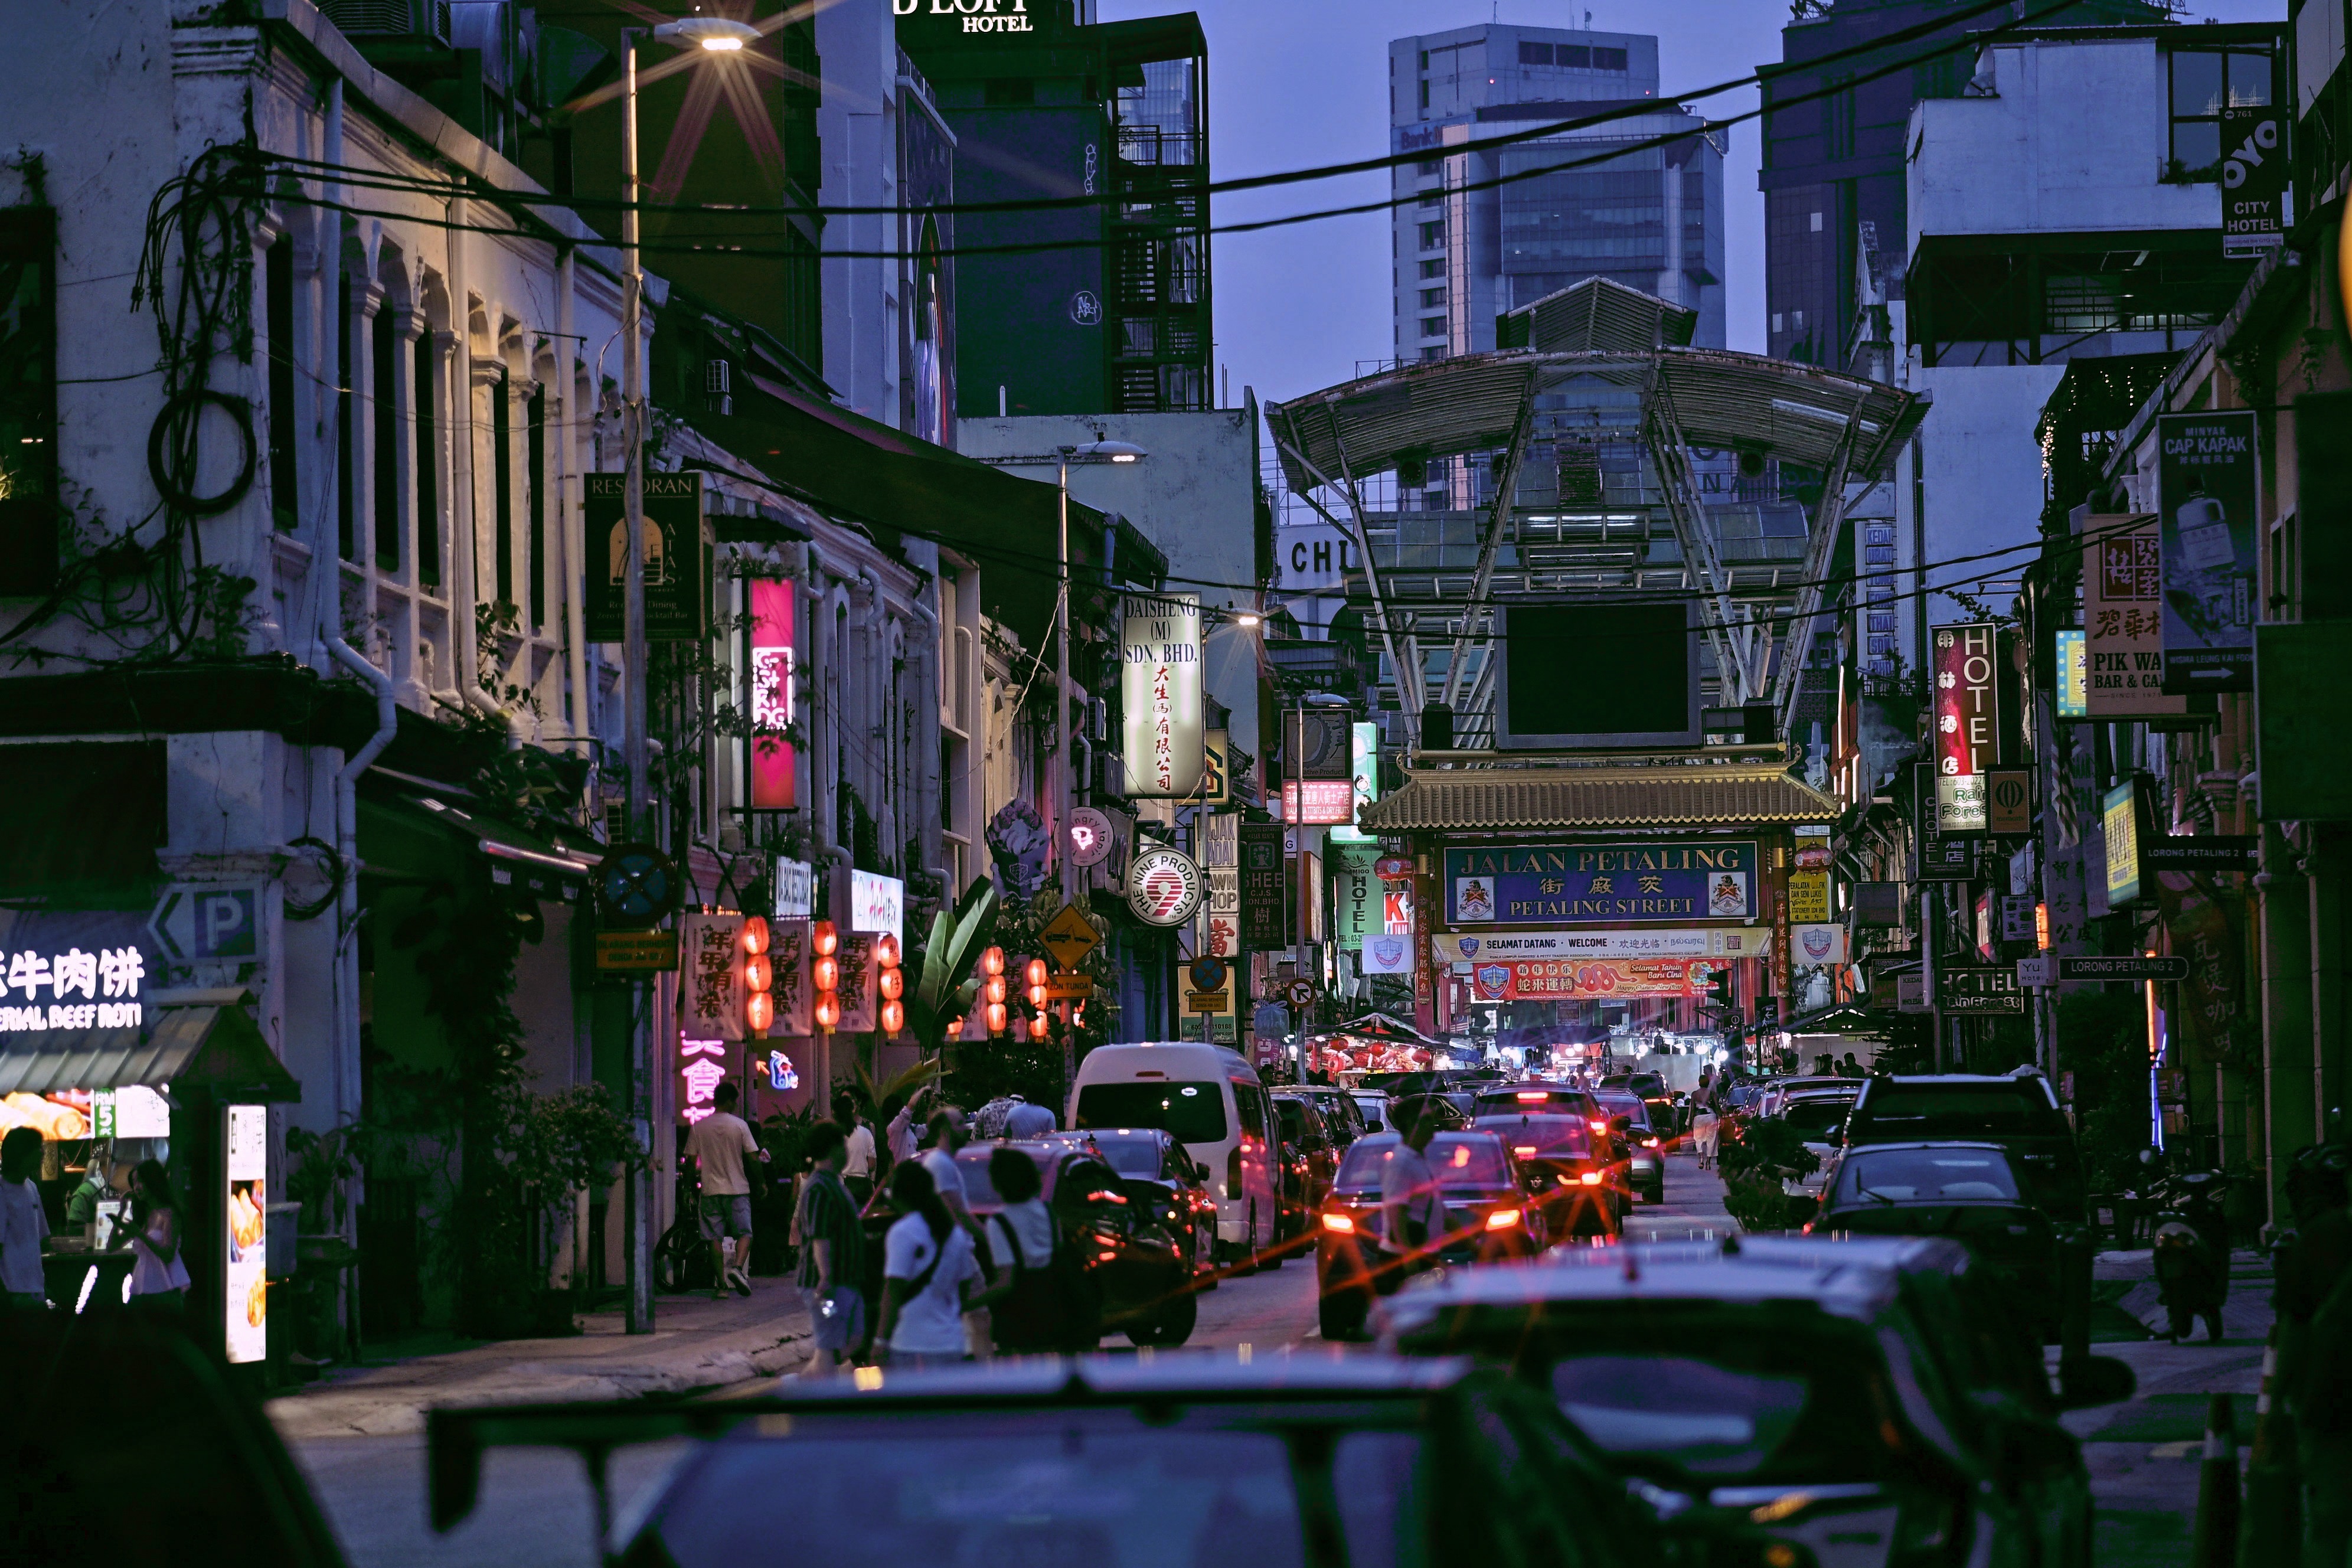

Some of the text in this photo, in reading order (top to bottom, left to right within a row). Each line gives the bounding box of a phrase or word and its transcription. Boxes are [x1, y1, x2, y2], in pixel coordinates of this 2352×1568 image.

[962, 16, 1033, 32] HOTEL
[2224, 120, 2277, 189] OYO
[2234, 201, 2270, 215] CITY
[2227, 218, 2278, 233] HOTEL
[2186, 426, 2226, 436] MINYAK
[2165, 436, 2247, 454] CAP KAPAK
[593, 478, 692, 494] RESORAN
[1126, 598, 1196, 618] DAISHENG
[1151, 620, 1171, 641] (M)
[1125, 643, 1198, 664] SDN. BHD.
[2094, 652, 2161, 671] PIK WA
[2094, 674, 2162, 688] BAR & CA
[1964, 629, 1991, 774] HOTEL
[1335, 806, 1350, 814] FRUITS
[1940, 803, 1985, 819] Fores
[1072, 816, 1100, 828] ngry
[1461, 848, 1740, 874] JALAN PETALING
[1133, 855, 1195, 914] THE NINE PRODUCTS
[1209, 874, 1236, 890] AWN
[1210, 892, 1236, 909] HOP
[1352, 877, 1366, 933] HOTEL
[1510, 898, 1694, 916] PETALING STREET
[206, 896, 243, 950] P
[1254, 908, 1269, 923] 樹
[1487, 938, 1607, 949] SELAMAT DATANG WELCOME
[1619, 939, 1660, 949] 欢迎光临
[0, 945, 145, 1001] 牛肉饼
[1519, 965, 1570, 974] 新年快乐
[2023, 963, 2040, 973] Yu
[2071, 961, 2173, 972] LORONG PETALING 2
[49, 1004, 97, 1030] BEEF
[98, 1003, 142, 1028] ROTI
[95, 1092, 115, 1106] RM
[99, 1106, 113, 1127] 5
